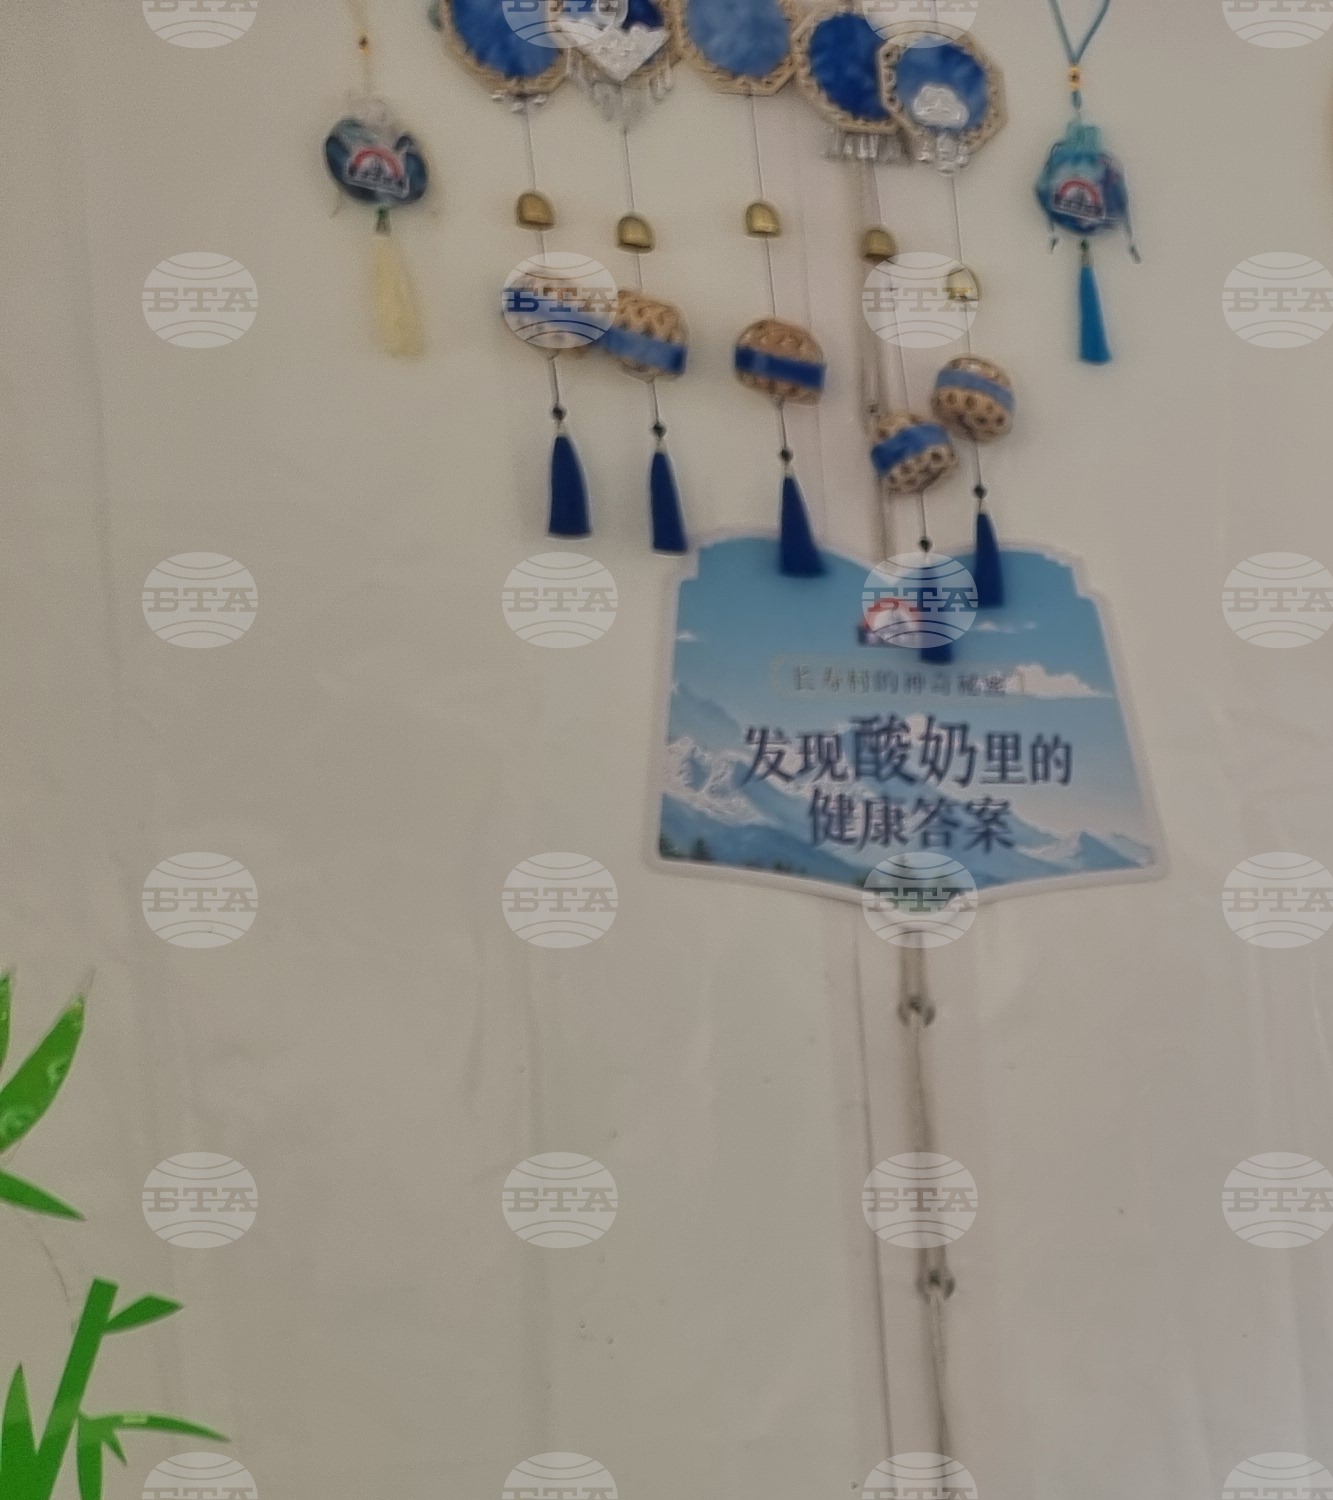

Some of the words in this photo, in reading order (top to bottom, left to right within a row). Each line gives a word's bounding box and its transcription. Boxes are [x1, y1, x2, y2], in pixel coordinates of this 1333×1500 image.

[741, 714, 1073, 786] 发现酸奶里的
[808, 789, 1014, 854] 健康答案
